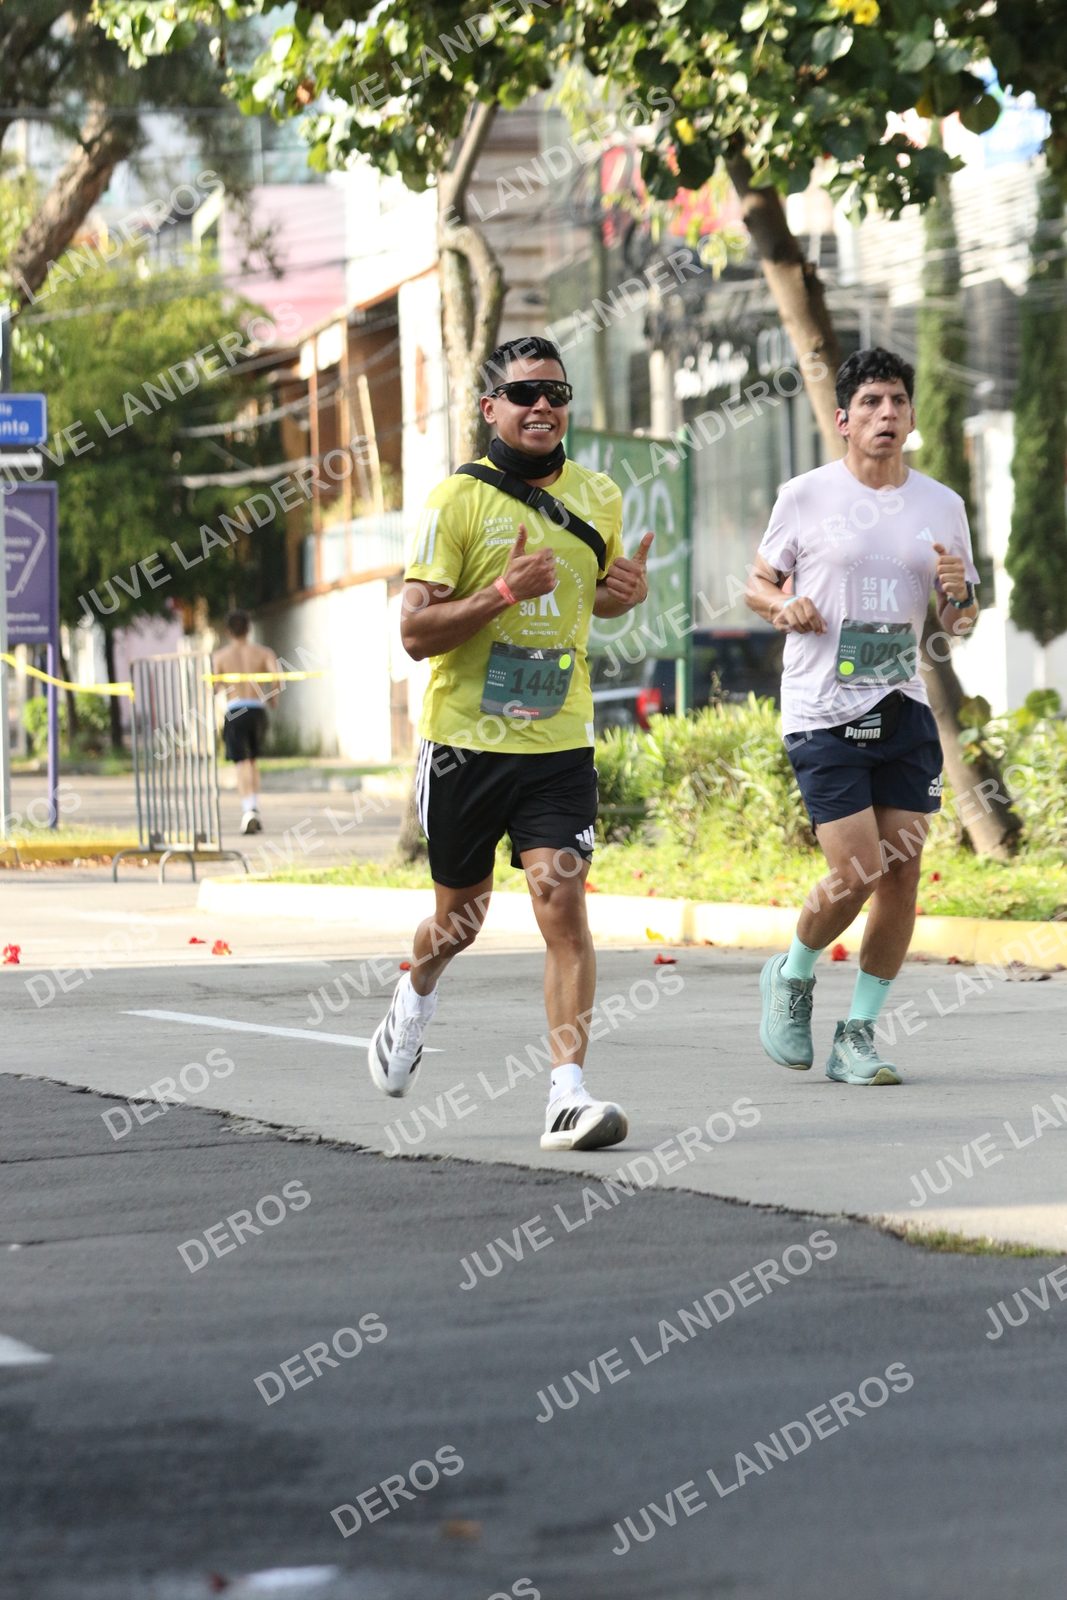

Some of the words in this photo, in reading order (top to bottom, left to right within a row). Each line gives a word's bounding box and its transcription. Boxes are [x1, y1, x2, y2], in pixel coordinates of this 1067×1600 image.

[0, 418, 30, 436] nto
[863, 577, 878, 591] 15
[880, 578, 899, 613] K
[520, 601, 536, 616] 30
[862, 597, 878, 610] 30
[509, 668, 570, 697] 1445
[845, 726, 882, 740] PUMA
